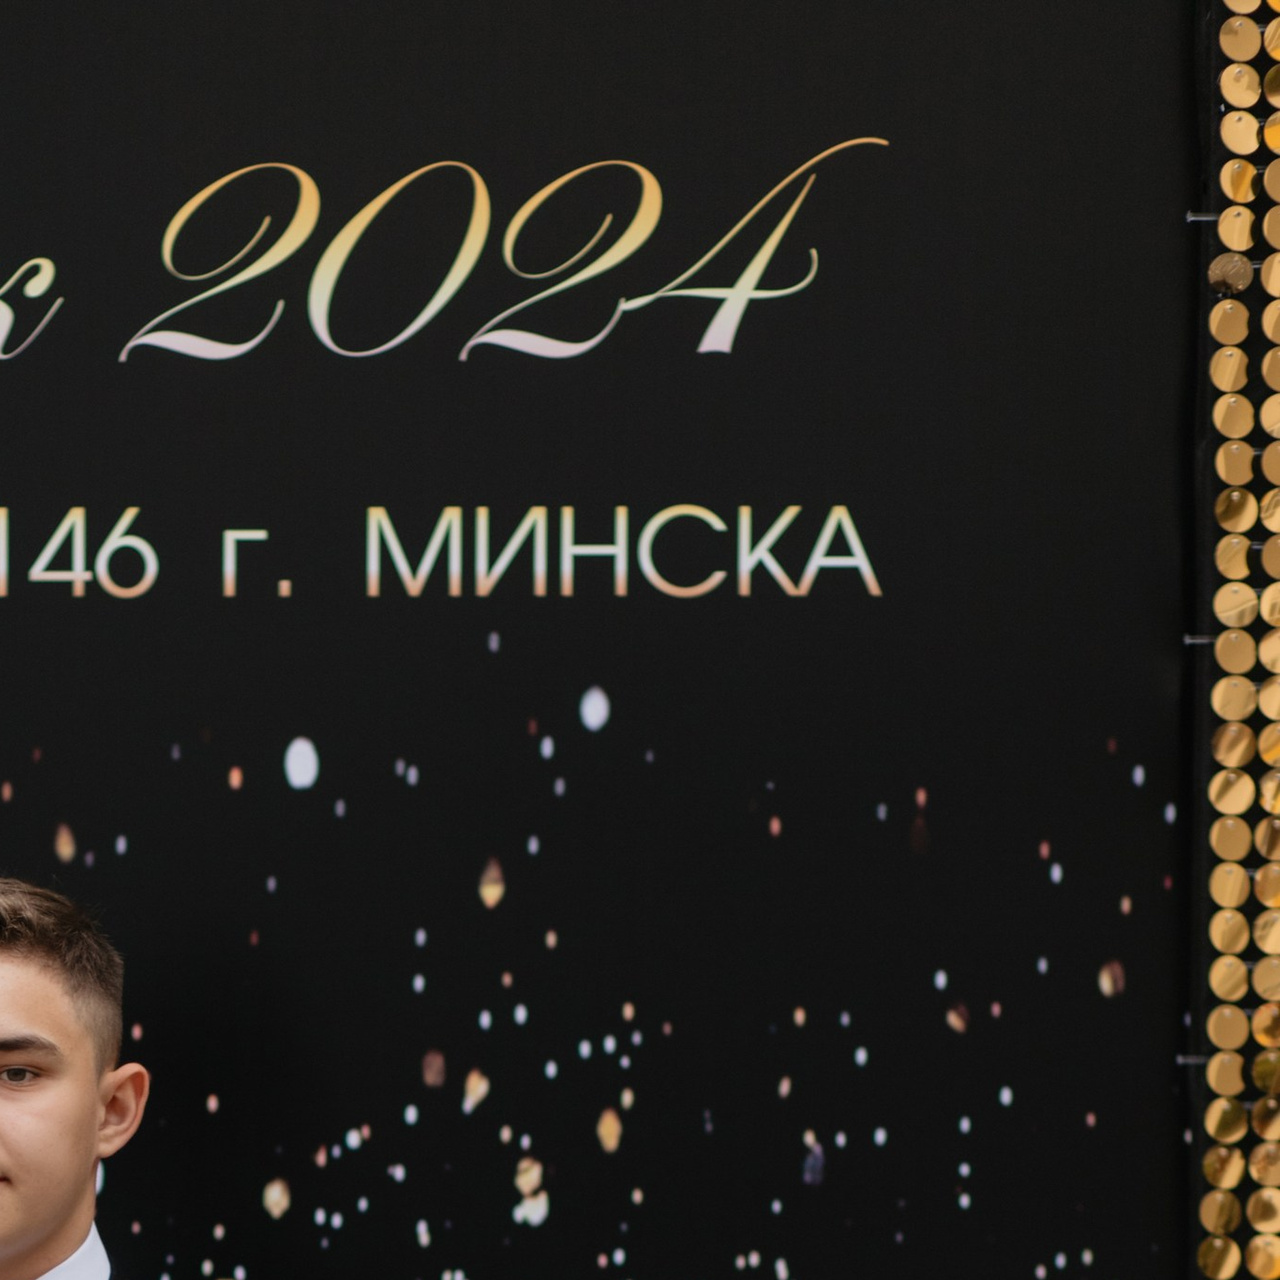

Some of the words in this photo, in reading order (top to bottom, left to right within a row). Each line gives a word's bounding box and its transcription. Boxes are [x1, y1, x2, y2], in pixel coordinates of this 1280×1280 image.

[117, 136, 891, 363] 2024
[221, 528, 294, 599] г.
[365, 503, 884, 599] МИНСКА
